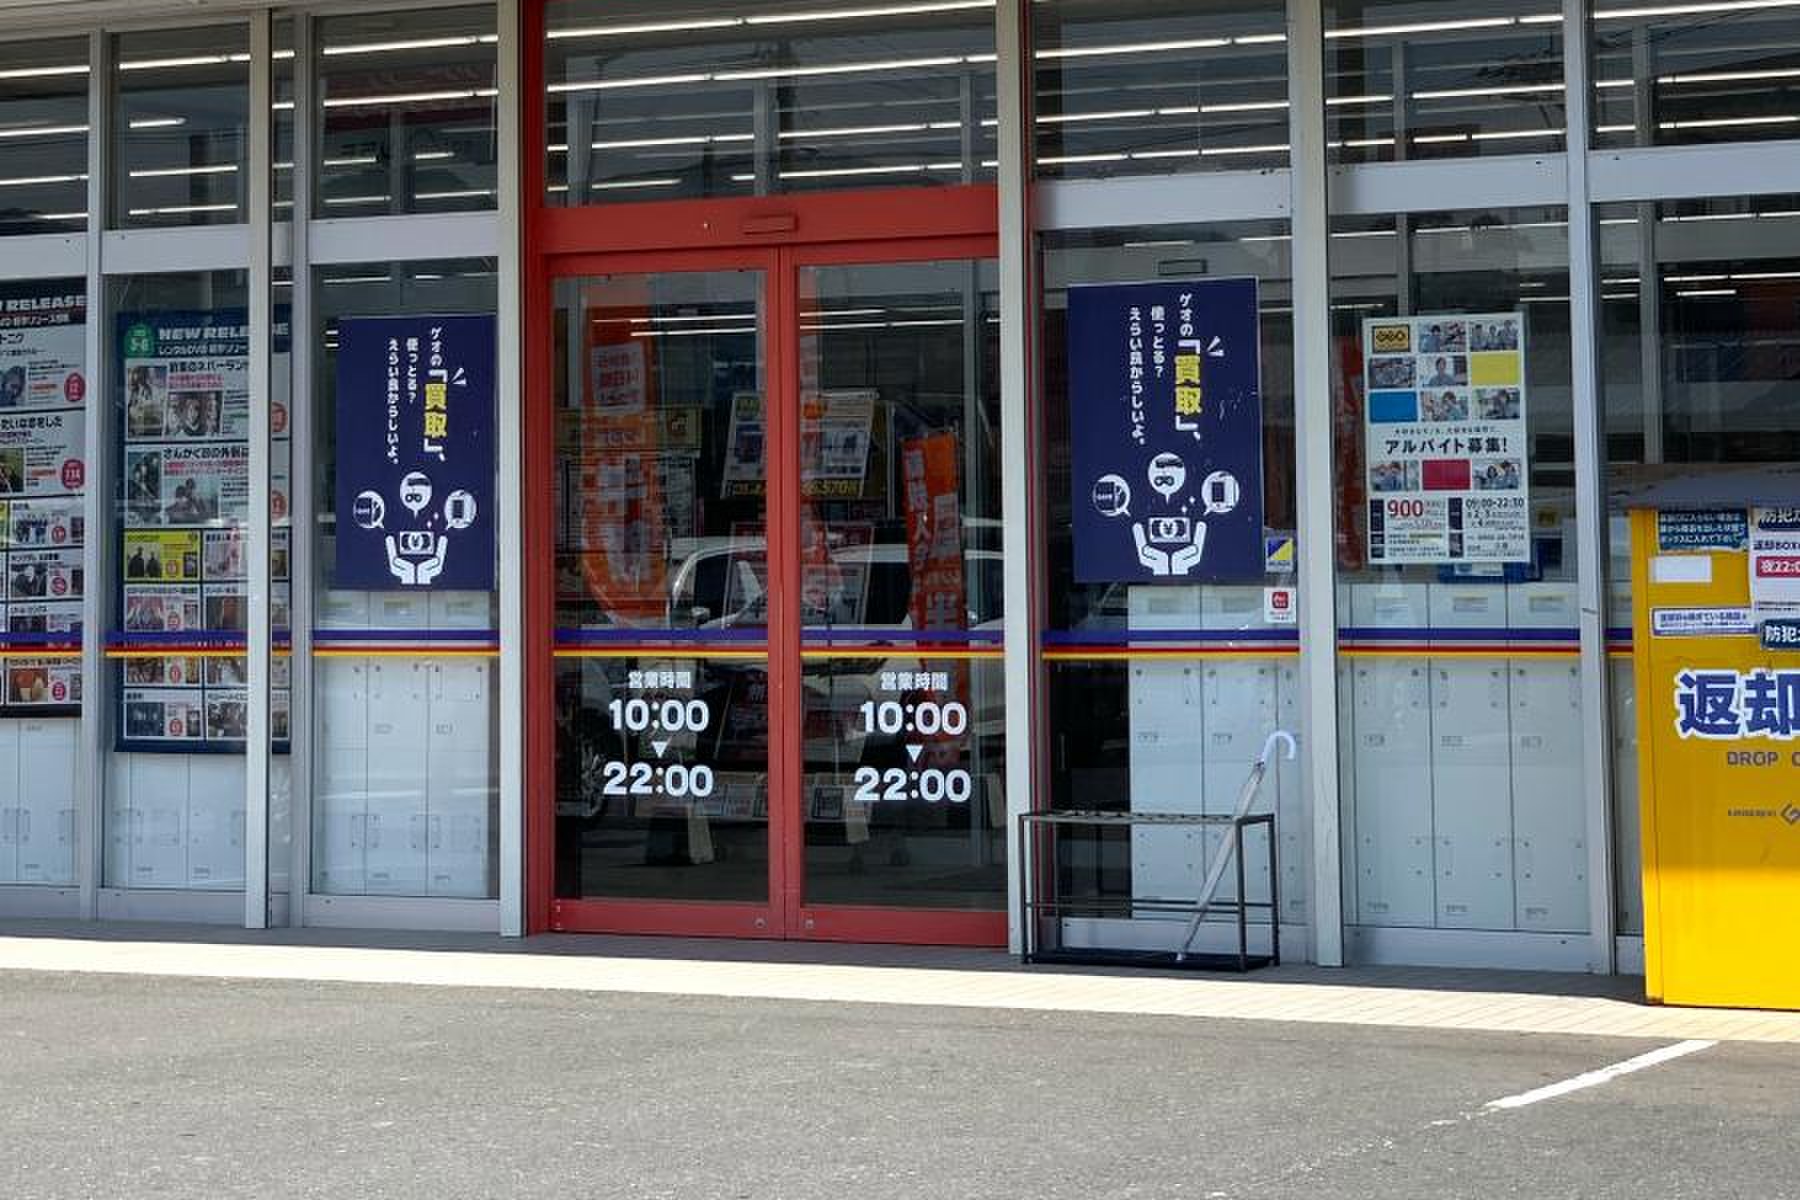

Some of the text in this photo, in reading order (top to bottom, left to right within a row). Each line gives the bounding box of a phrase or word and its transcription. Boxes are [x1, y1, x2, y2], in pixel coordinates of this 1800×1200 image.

[1387, 500, 1424, 517] 900
[1764, 625, 1800, 642] 防犯
[628, 671, 692, 689] 営業時間
[880, 672, 949, 691] 営業時間
[609, 699, 710, 732] 10:00
[1677, 670, 1800, 737] 返却
[860, 701, 967, 735] 10:00
[1727, 751, 1779, 767] DROP
[603, 761, 714, 797] 22:00
[853, 767, 972, 802] 22:00
